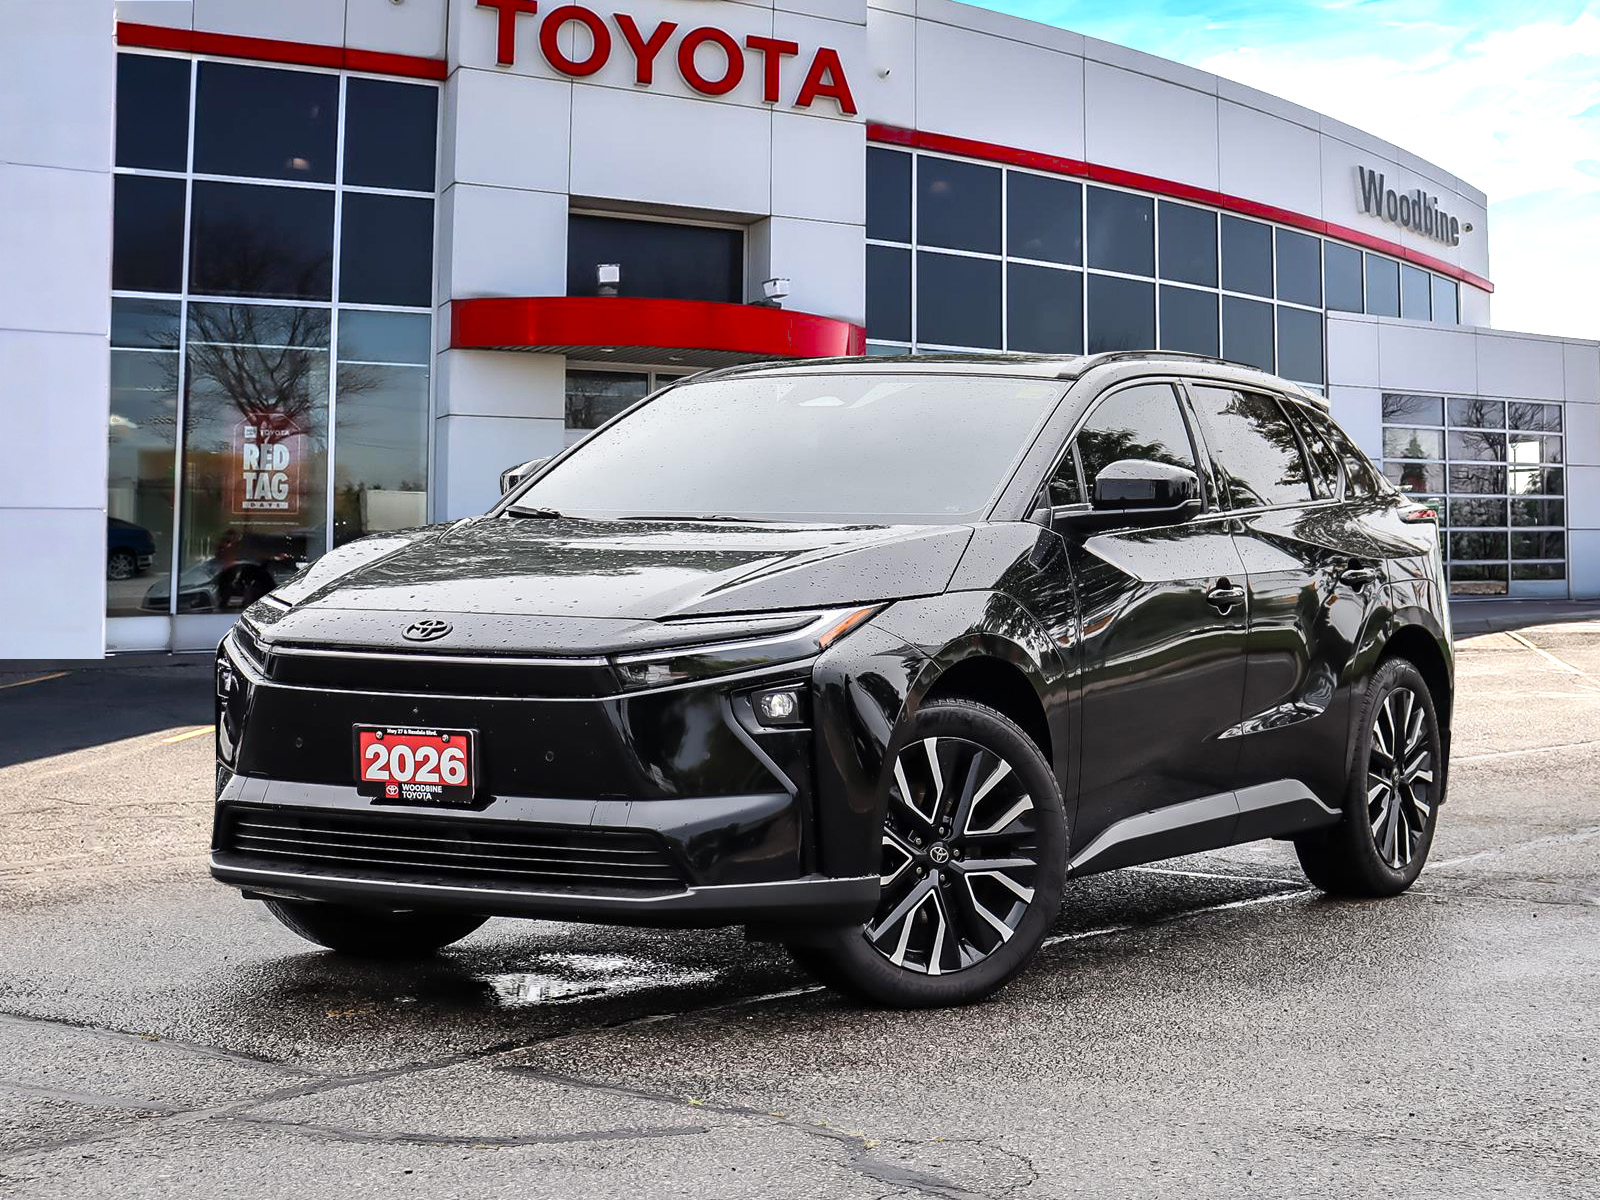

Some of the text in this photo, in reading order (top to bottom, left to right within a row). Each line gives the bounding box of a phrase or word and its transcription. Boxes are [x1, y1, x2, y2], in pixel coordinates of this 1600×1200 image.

[477, 0, 858, 116] TOYOTA
[1358, 165, 1460, 247] Woodbine
[260, 429, 290, 437] TOYOTA
[243, 443, 290, 471] RED
[243, 472, 290, 500] TAG
[365, 743, 466, 785] 2026
[401, 783, 443, 793] WOODBINE
[401, 790, 433, 800] TOYOTA
